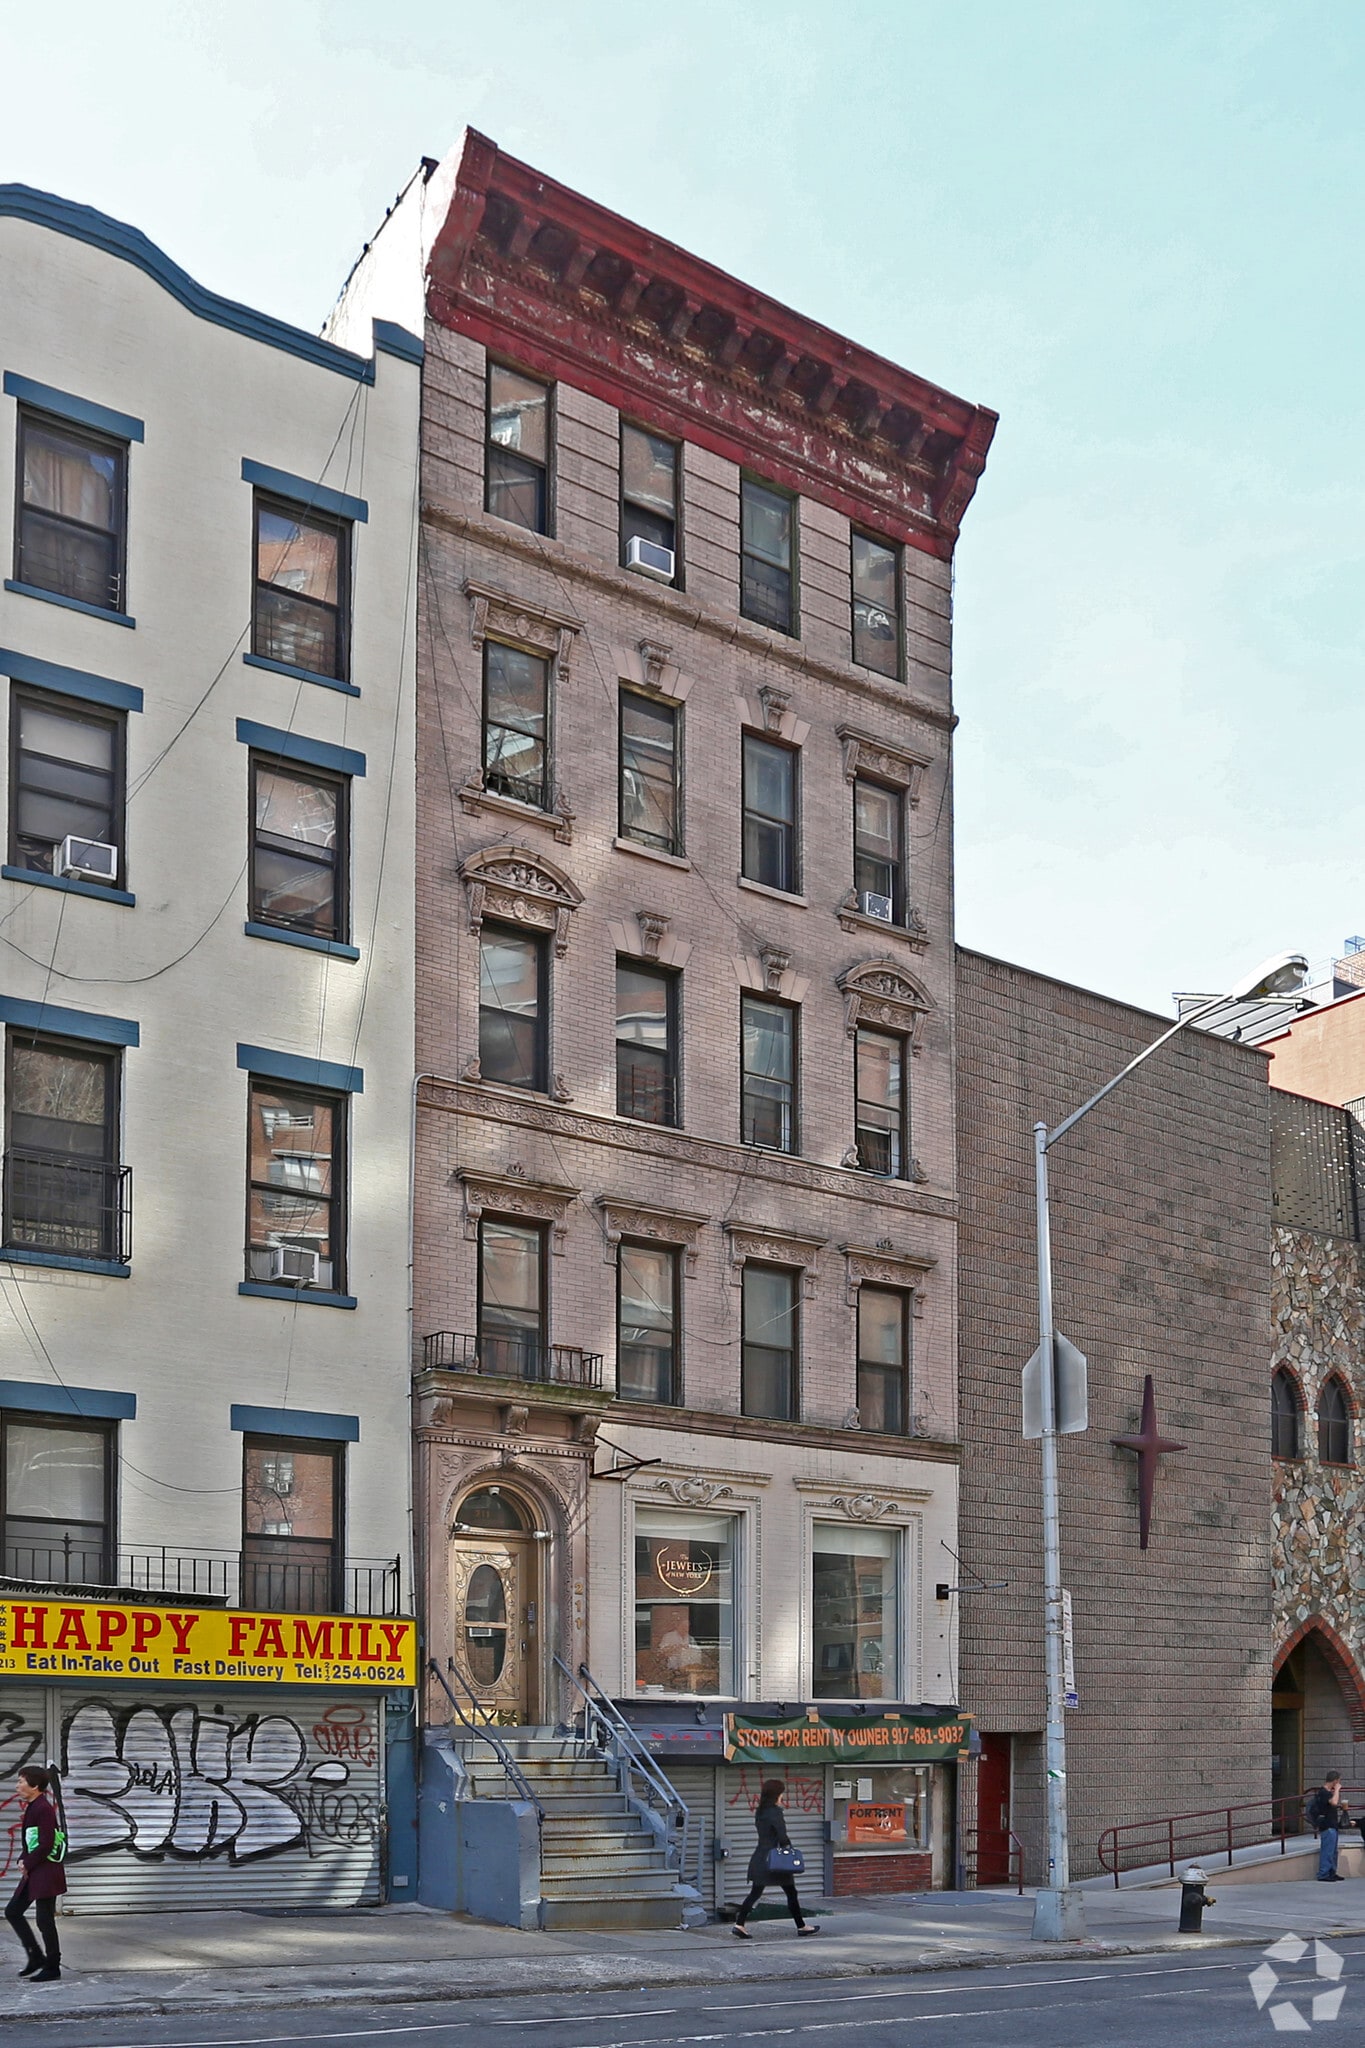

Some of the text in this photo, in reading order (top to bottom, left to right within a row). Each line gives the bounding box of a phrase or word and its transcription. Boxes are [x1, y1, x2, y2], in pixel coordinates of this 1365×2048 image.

[666, 1560, 703, 1571] JEWELS
[686, 1571, 702, 1579] YORK
[54, 1584, 111, 1600] CURTAIN
[11, 1606, 409, 1662] HAPPY FAMILY
[26, 1653, 57, 1669] Eat
[62, 1654, 123, 1672] In-Take
[128, 1657, 160, 1673] Out
[174, 1658, 210, 1675] Fast
[215, 1660, 284, 1681] Delivery
[295, 1663, 323, 1679] Tel:
[333, 1665, 405, 1681] 254-0624
[737, 1726, 964, 1747] STORE FOR RENT BY OWNER 917-681-9032
[849, 1808, 872, 1819] FOR
